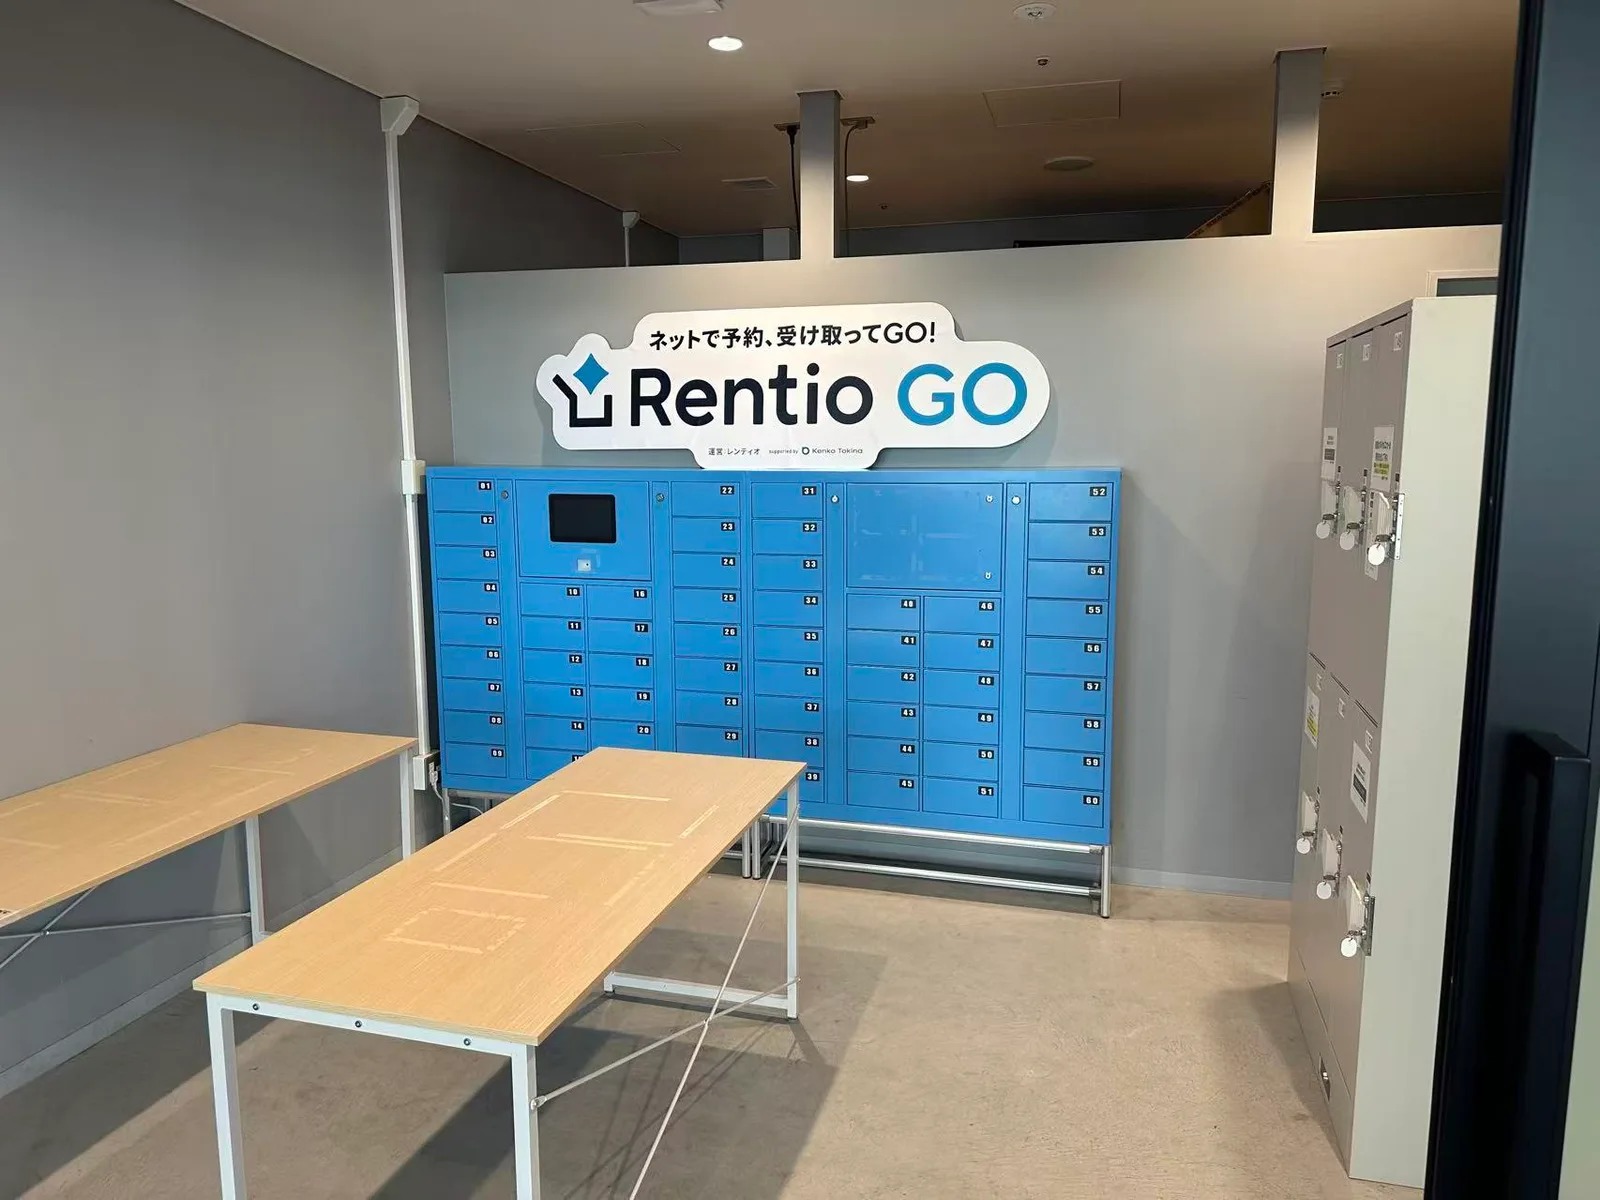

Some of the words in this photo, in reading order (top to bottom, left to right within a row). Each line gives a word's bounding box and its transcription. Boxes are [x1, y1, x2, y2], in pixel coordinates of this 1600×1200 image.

[649, 321, 936, 351] ネットで予約、受け取ってGO!
[630, 362, 874, 427] Rentio
[897, 362, 1028, 427] GO
[812, 447, 836, 455] Kenko
[837, 447, 863, 455] Tokina
[480, 482, 490, 490] 01
[722, 486, 733, 494] 22
[803, 487, 814, 495] 31
[1092, 487, 1106, 496] 52
[482, 516, 493, 524] 02
[722, 523, 733, 531] 23
[804, 523, 816, 531] 32
[1091, 527, 1104, 536] 53
[484, 550, 495, 558] 03
[723, 558, 734, 566] 24
[805, 560, 816, 568] 33
[1090, 566, 1103, 575] 54
[568, 588, 578, 596] 10
[635, 590, 645, 598] 16
[805, 596, 817, 604] 34
[980, 602, 993, 610] 46
[1088, 606, 1101, 614] 55
[487, 617, 498, 625] 05
[636, 624, 645, 632] 17
[724, 628, 736, 636] 26
[806, 632, 817, 640] 35
[903, 636, 915, 644] 41
[980, 639, 992, 647] 47
[1087, 644, 1100, 653] 56
[571, 655, 580, 663] 12
[726, 663, 736, 671] 27
[806, 668, 817, 676] 36
[903, 673, 915, 681] 42
[980, 676, 991, 685] 48
[1086, 682, 1099, 691] 57
[572, 688, 582, 696] 13
[807, 703, 818, 711] 37
[903, 709, 914, 717] 43
[980, 714, 992, 722] 49
[573, 722, 582, 730] 14
[1086, 720, 1099, 729] 58
[806, 738, 818, 746] 38
[902, 745, 912, 753] 44
[981, 750, 993, 759] 50
[1086, 758, 1099, 766] 59
[806, 772, 818, 781] 39
[901, 780, 913, 788] 45
[980, 787, 992, 796] 51
